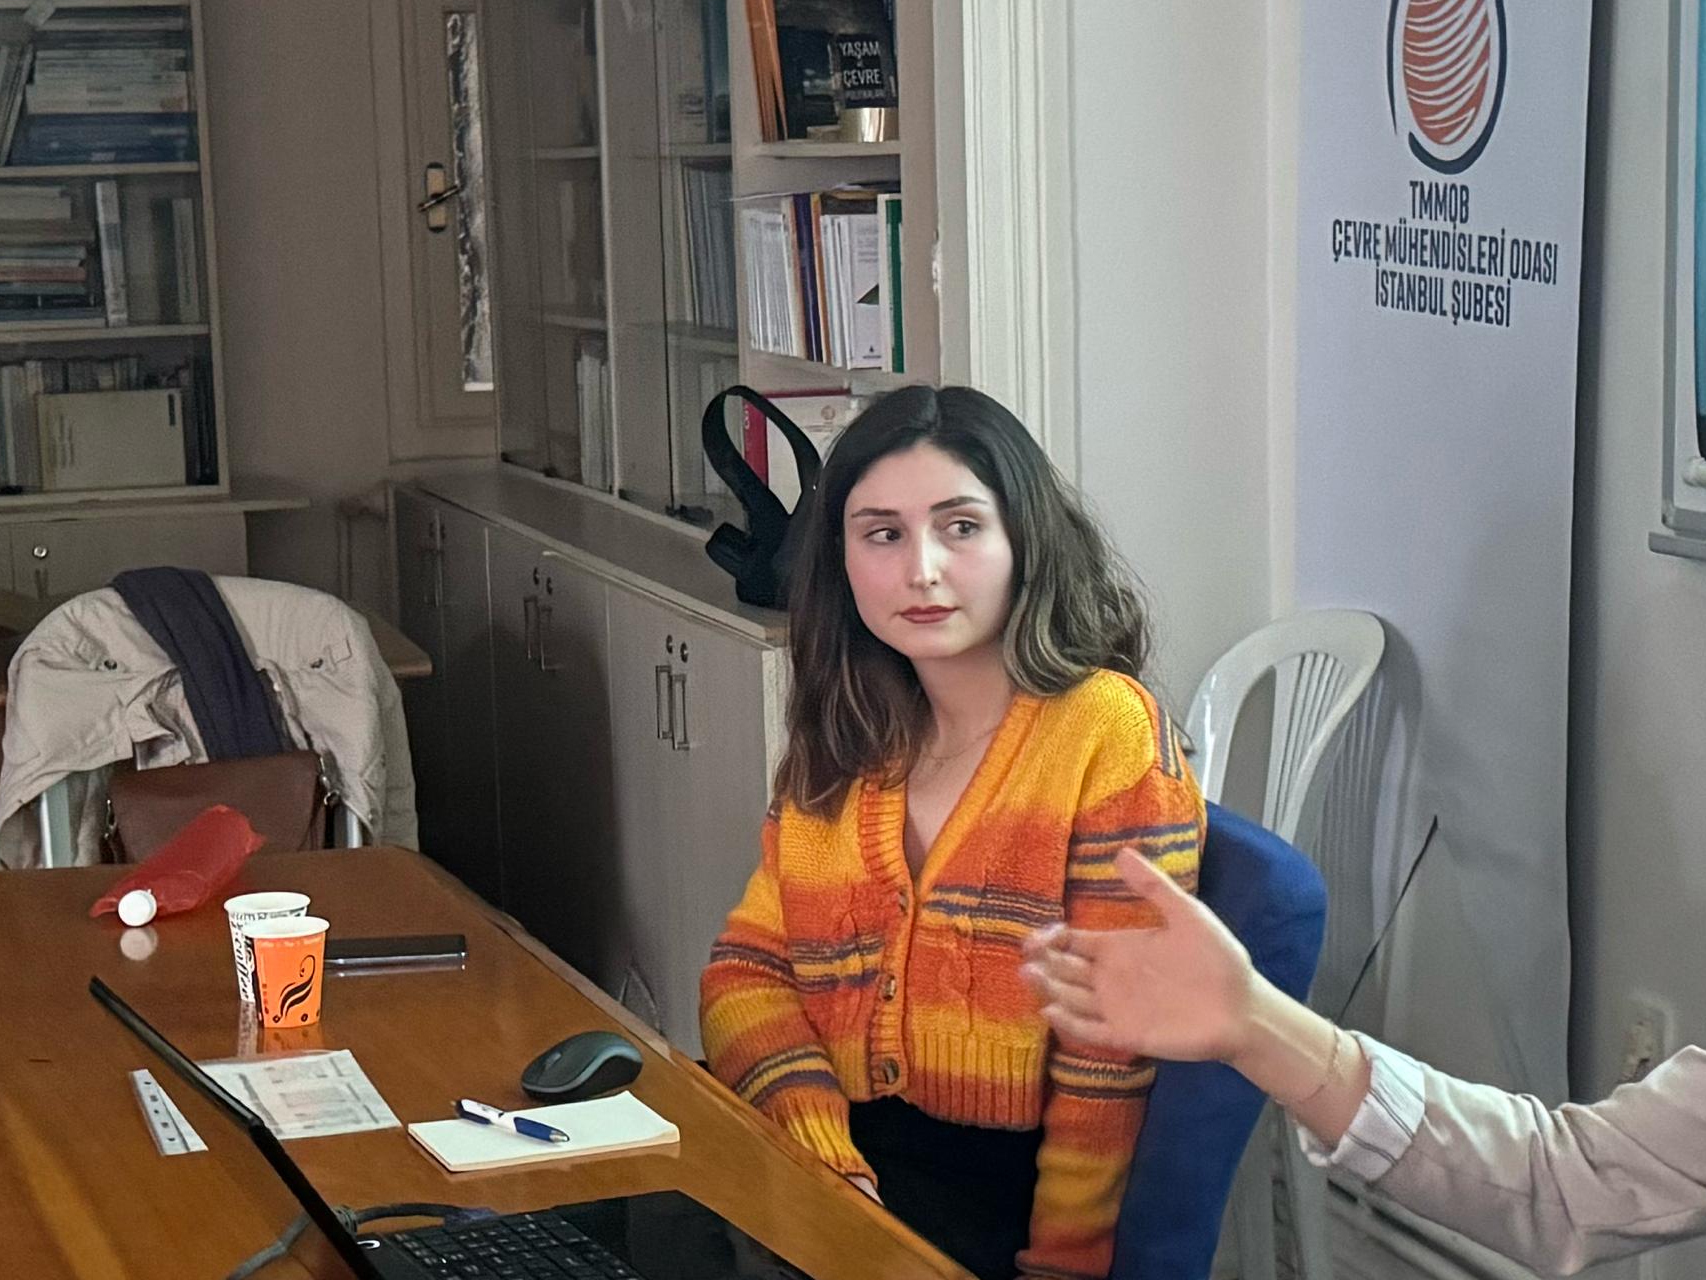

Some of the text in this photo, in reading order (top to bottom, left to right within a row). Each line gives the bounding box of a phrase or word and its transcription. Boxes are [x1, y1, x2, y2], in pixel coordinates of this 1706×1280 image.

[839, 41, 881, 59] YAŞAM
[844, 69, 882, 87] ÇEVRE
[1409, 180, 1470, 224] TMMOB
[1332, 218, 1558, 285] ÇEVRE MÜHENDİSLERİ ODASI
[1375, 261, 1511, 327] İSTANBUL ŞUBESİ
